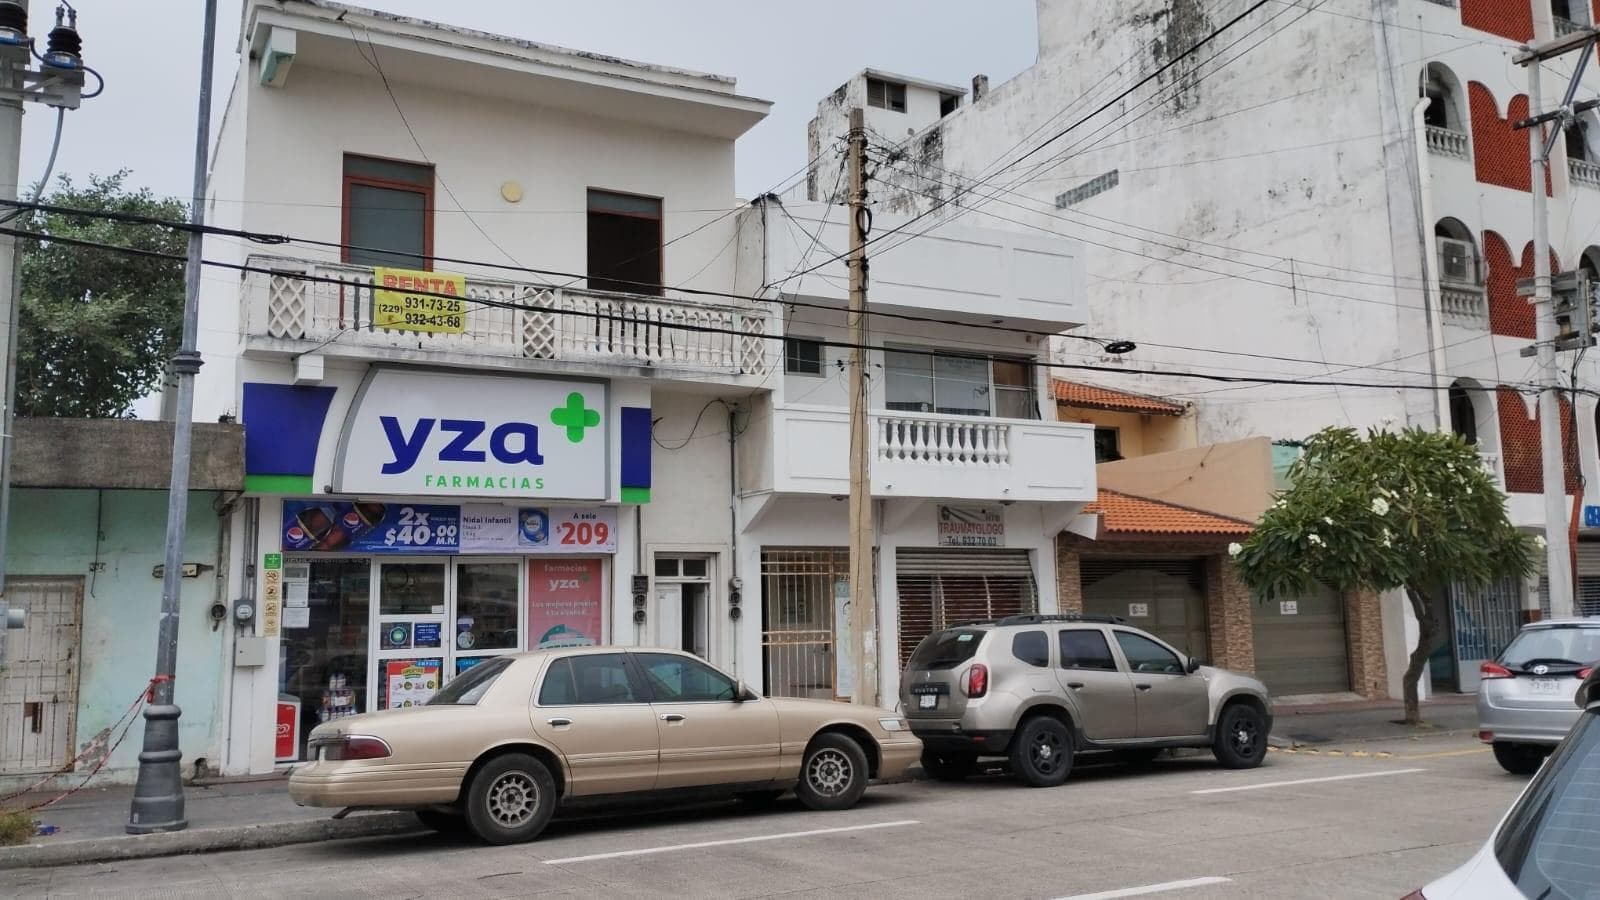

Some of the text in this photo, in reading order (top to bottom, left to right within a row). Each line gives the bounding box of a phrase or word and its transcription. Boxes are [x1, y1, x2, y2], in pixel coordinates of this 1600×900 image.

[383, 274, 457, 296] RENTA
[378, 303, 403, 314] (229)
[405, 297, 460, 312] 931-73-25
[405, 312, 460, 328] 932-43-68
[380, 415, 545, 475] yza
[425, 475, 545, 490] FARMACIAS
[398, 507, 429, 526] 2x
[938, 522, 1004, 535] TRAUMATOLOGO
[549, 579, 580, 592] yza
